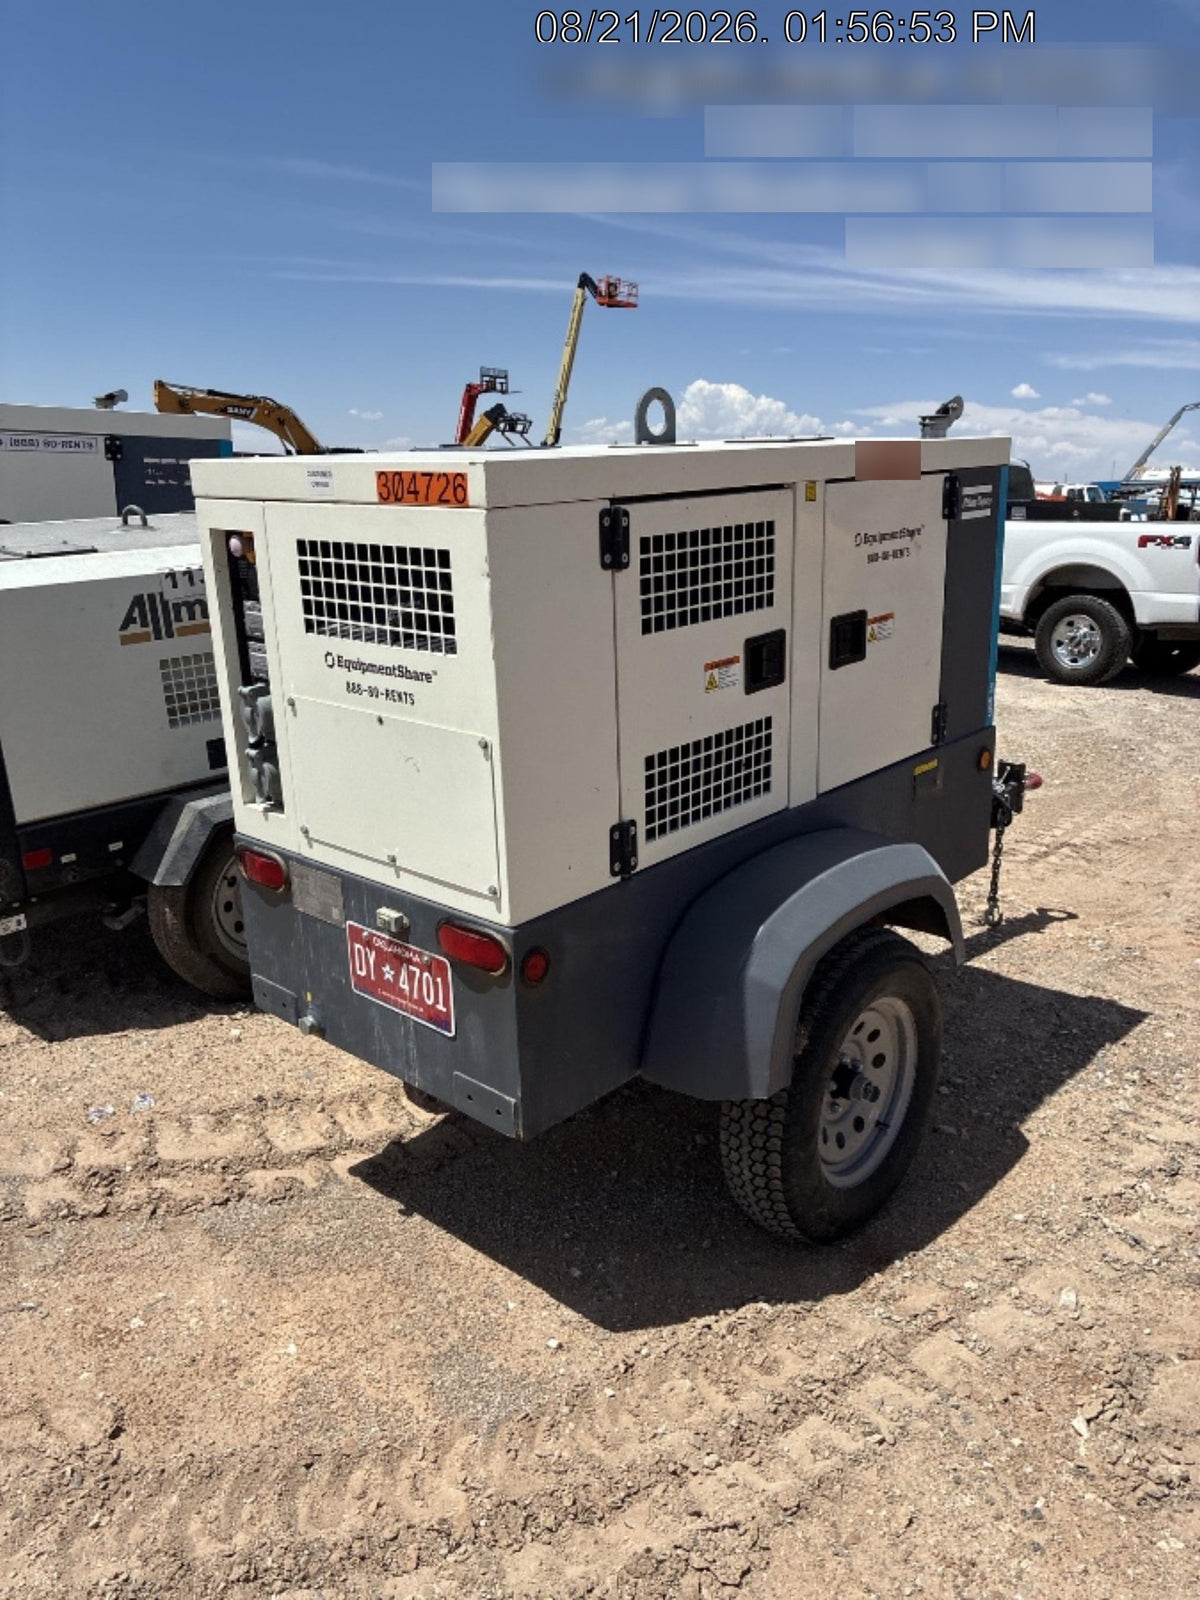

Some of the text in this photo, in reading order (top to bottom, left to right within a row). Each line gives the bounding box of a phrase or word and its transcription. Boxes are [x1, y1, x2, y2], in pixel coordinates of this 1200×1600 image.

[377, 471, 467, 504] 304726
[1137, 534, 1192, 548] FX4
[337, 655, 433, 683] EquipmentShare
[353, 942, 376, 981] DY
[399, 963, 447, 1012] 4701
